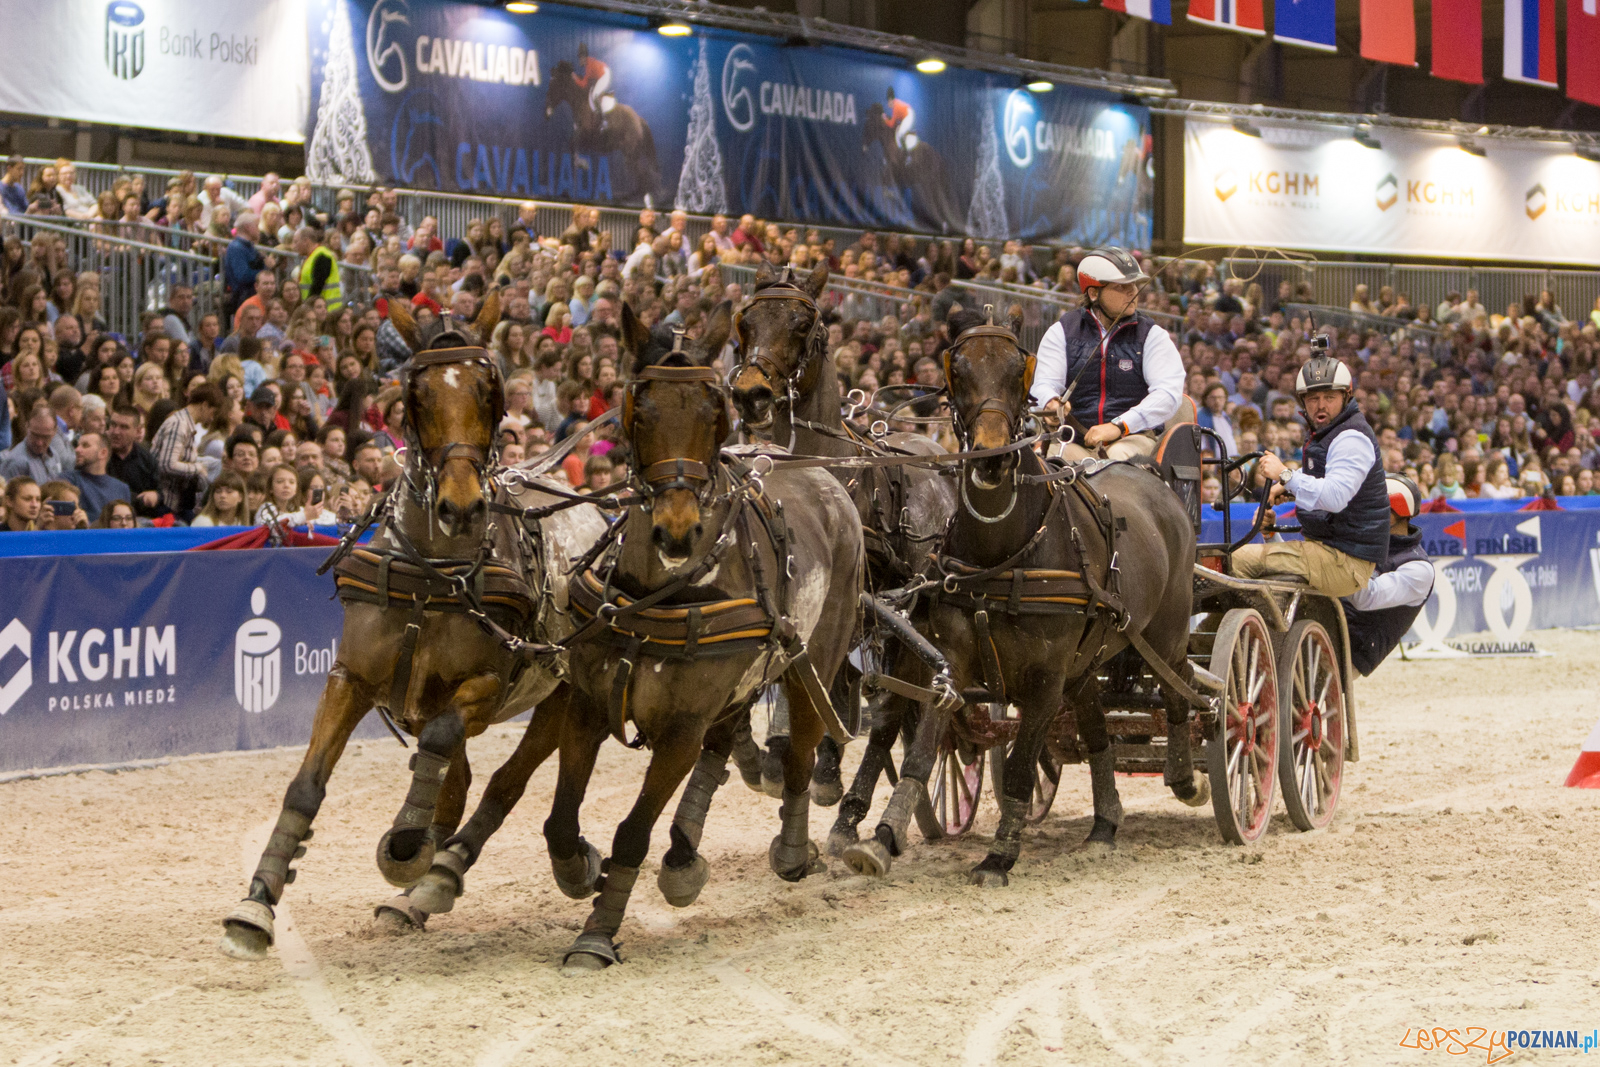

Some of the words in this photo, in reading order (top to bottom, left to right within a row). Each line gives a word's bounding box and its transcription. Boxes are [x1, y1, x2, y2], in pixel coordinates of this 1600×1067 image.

[160, 26, 203, 59] Bank
[210, 32, 259, 65] Polski
[415, 35, 541, 86] CAVALIADA
[760, 80, 857, 125] CAVALIADA
[1035, 120, 1116, 161] CAVALIADA
[455, 141, 613, 200] CAVALIADA
[1249, 170, 1320, 196] KGHM
[1406, 179, 1475, 206] KGHM
[1476, 537, 1537, 555] FINSH
[1444, 566, 1482, 592] ewex
[49, 624, 176, 684] KGHM
[1472, 641, 1537, 654] CAVALIADA
[49, 691, 114, 712] POLSKA
[125, 685, 176, 706] MIEDŹ
